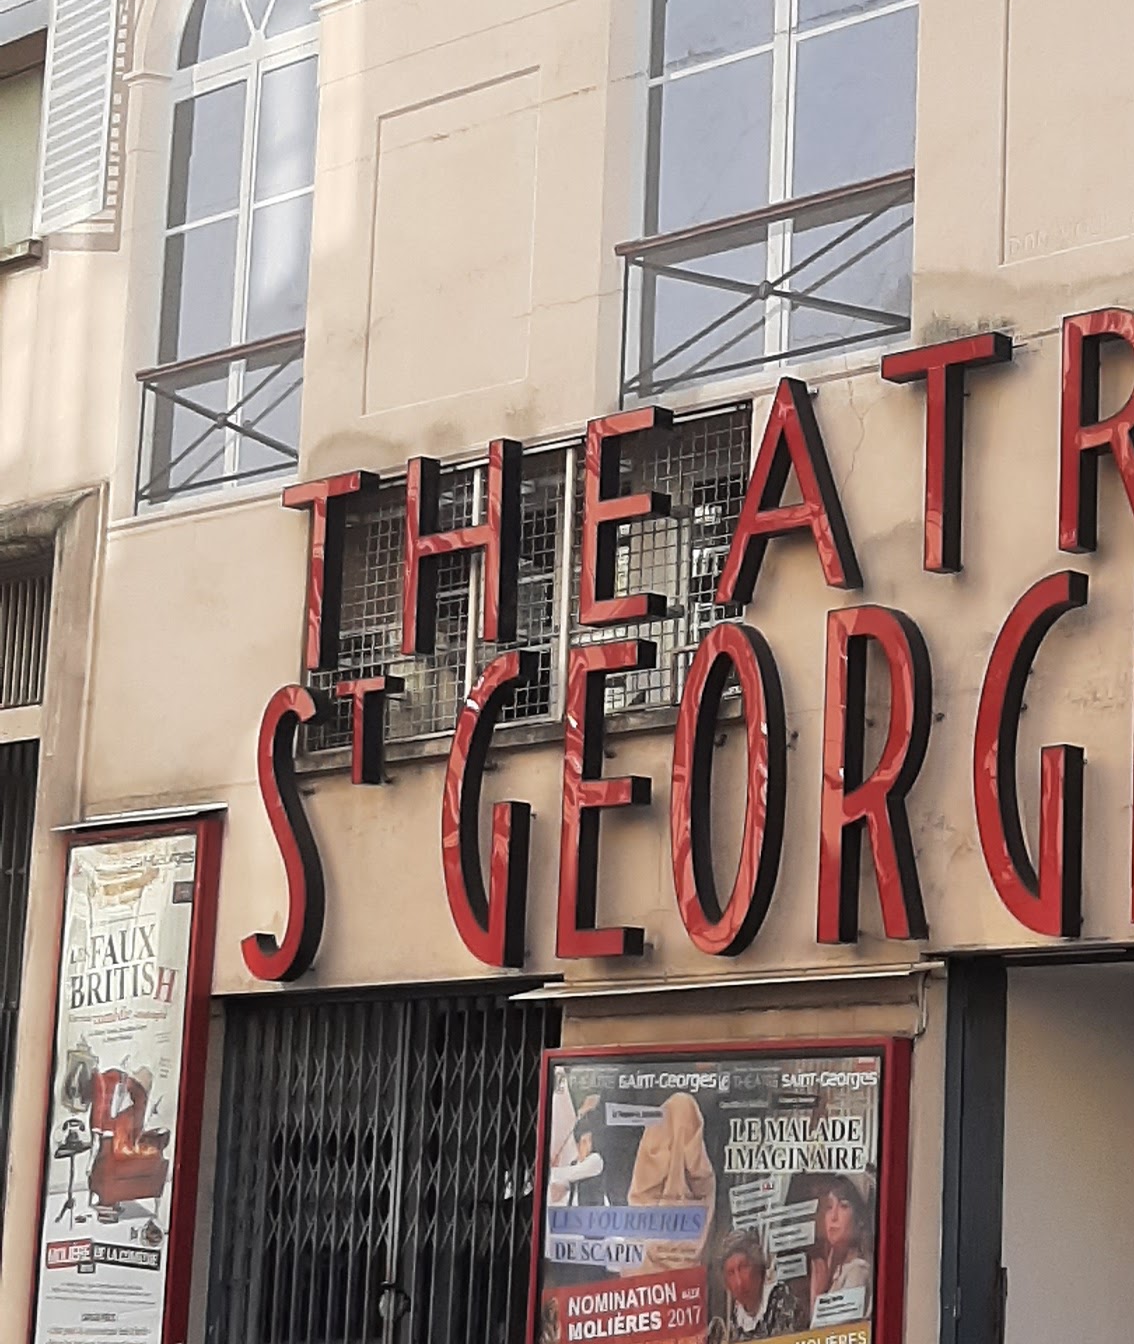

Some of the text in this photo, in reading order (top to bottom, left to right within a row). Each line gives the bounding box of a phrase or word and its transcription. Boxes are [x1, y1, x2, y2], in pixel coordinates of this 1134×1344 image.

[241, 675, 402, 983] ST
[90, 923, 156, 969] FAUX
[70, 961, 178, 1010] BRITISH
[731, 1118, 861, 1142] LE MALADE
[726, 1147, 864, 1170] IMAGINAIRE
[553, 1211, 700, 1232] LES FOURBERIES
[555, 1242, 574, 1260] DE
[580, 1243, 643, 1263] SCAPIN
[568, 1281, 677, 1317] NOMINATION
[568, 1306, 701, 1342] MOLIÈRES 2017
